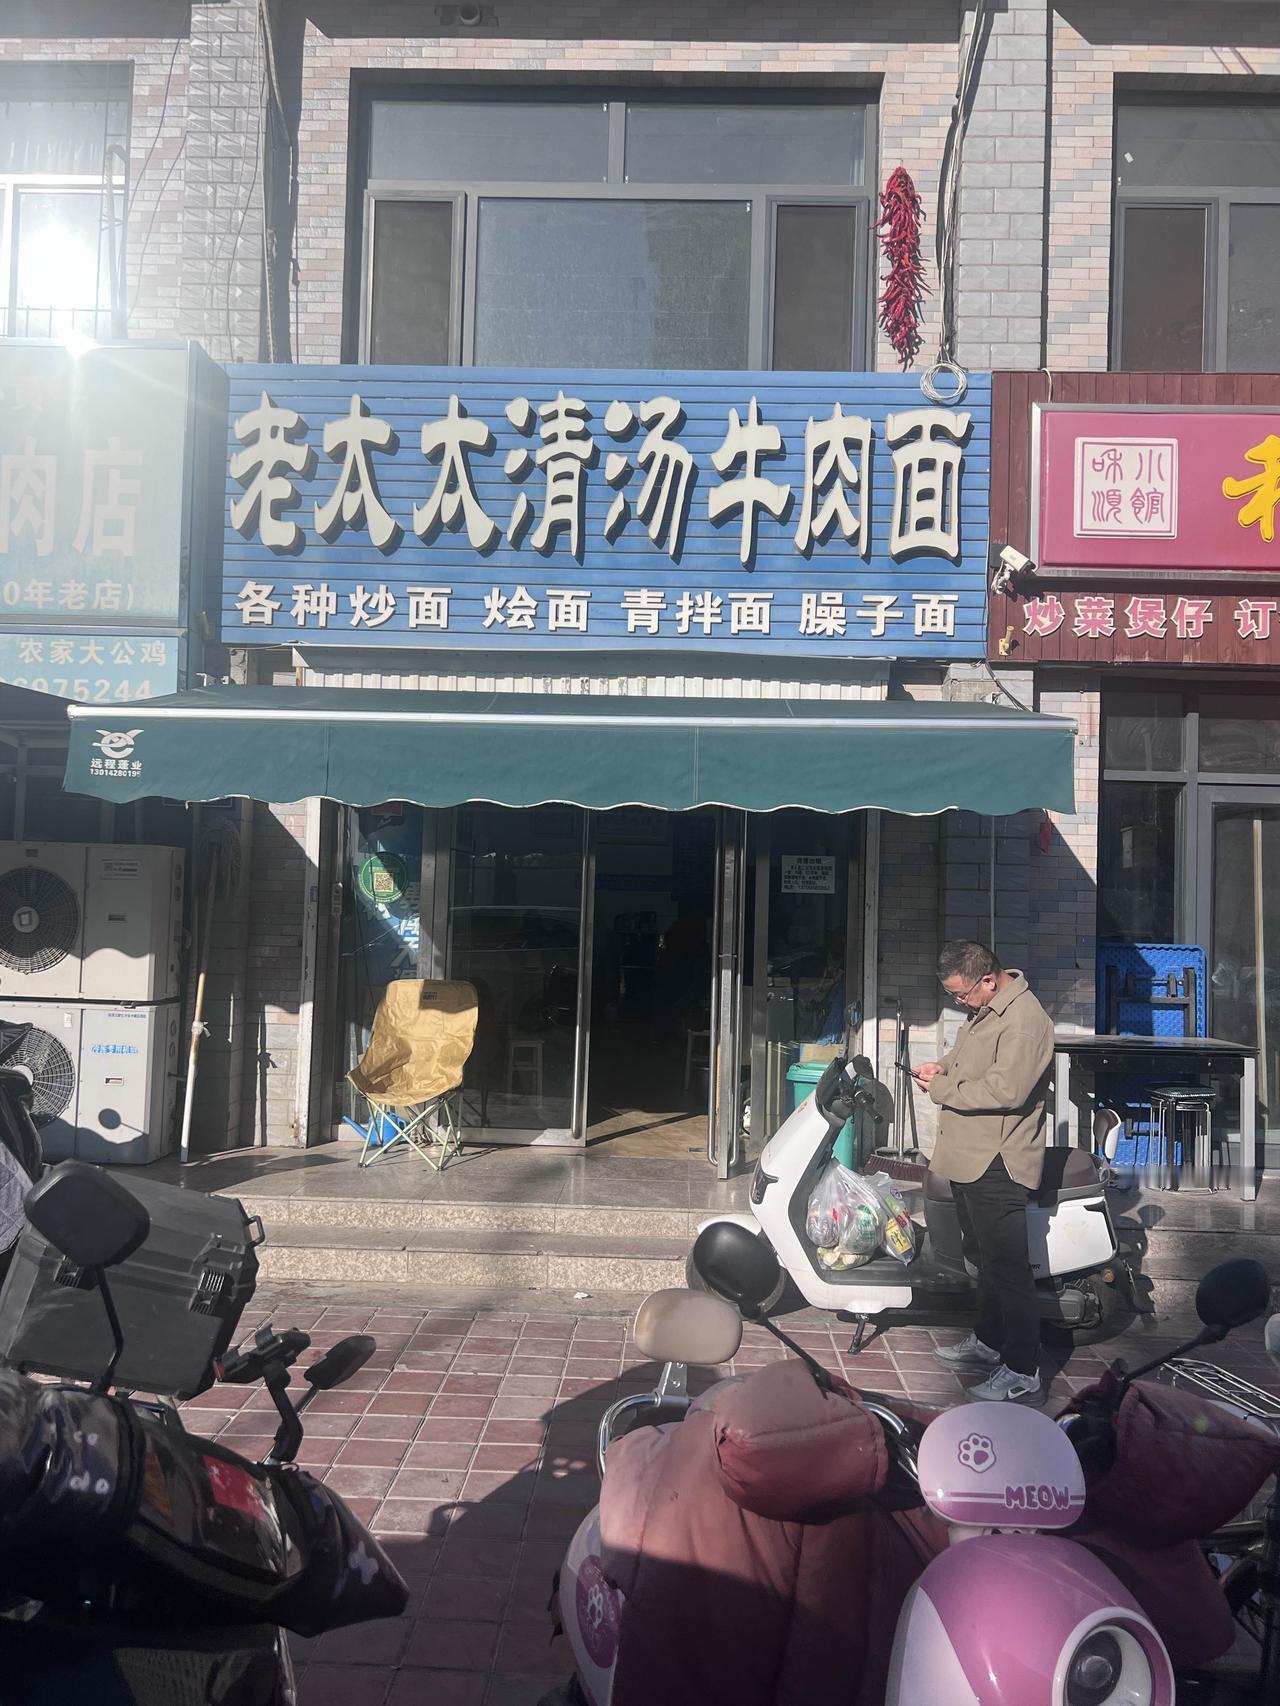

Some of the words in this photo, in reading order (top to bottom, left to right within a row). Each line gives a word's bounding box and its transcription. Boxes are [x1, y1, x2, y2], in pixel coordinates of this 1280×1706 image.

[0, 437, 143, 556] 肉店
[227, 389, 972, 565] 老太太清汤牛肉面
[235, 580, 453, 632] 各种炒面
[482, 586, 592, 634] 烩面
[621, 588, 775, 635] 青拌面
[798, 591, 960, 637] 臊子面
[1023, 594, 1213, 639] 炒菜煲仔
[1234, 598, 1280, 640] 订
[18, 638, 168, 667] 农家大公鸡
[1004, 1484, 1070, 1510] MEOW
